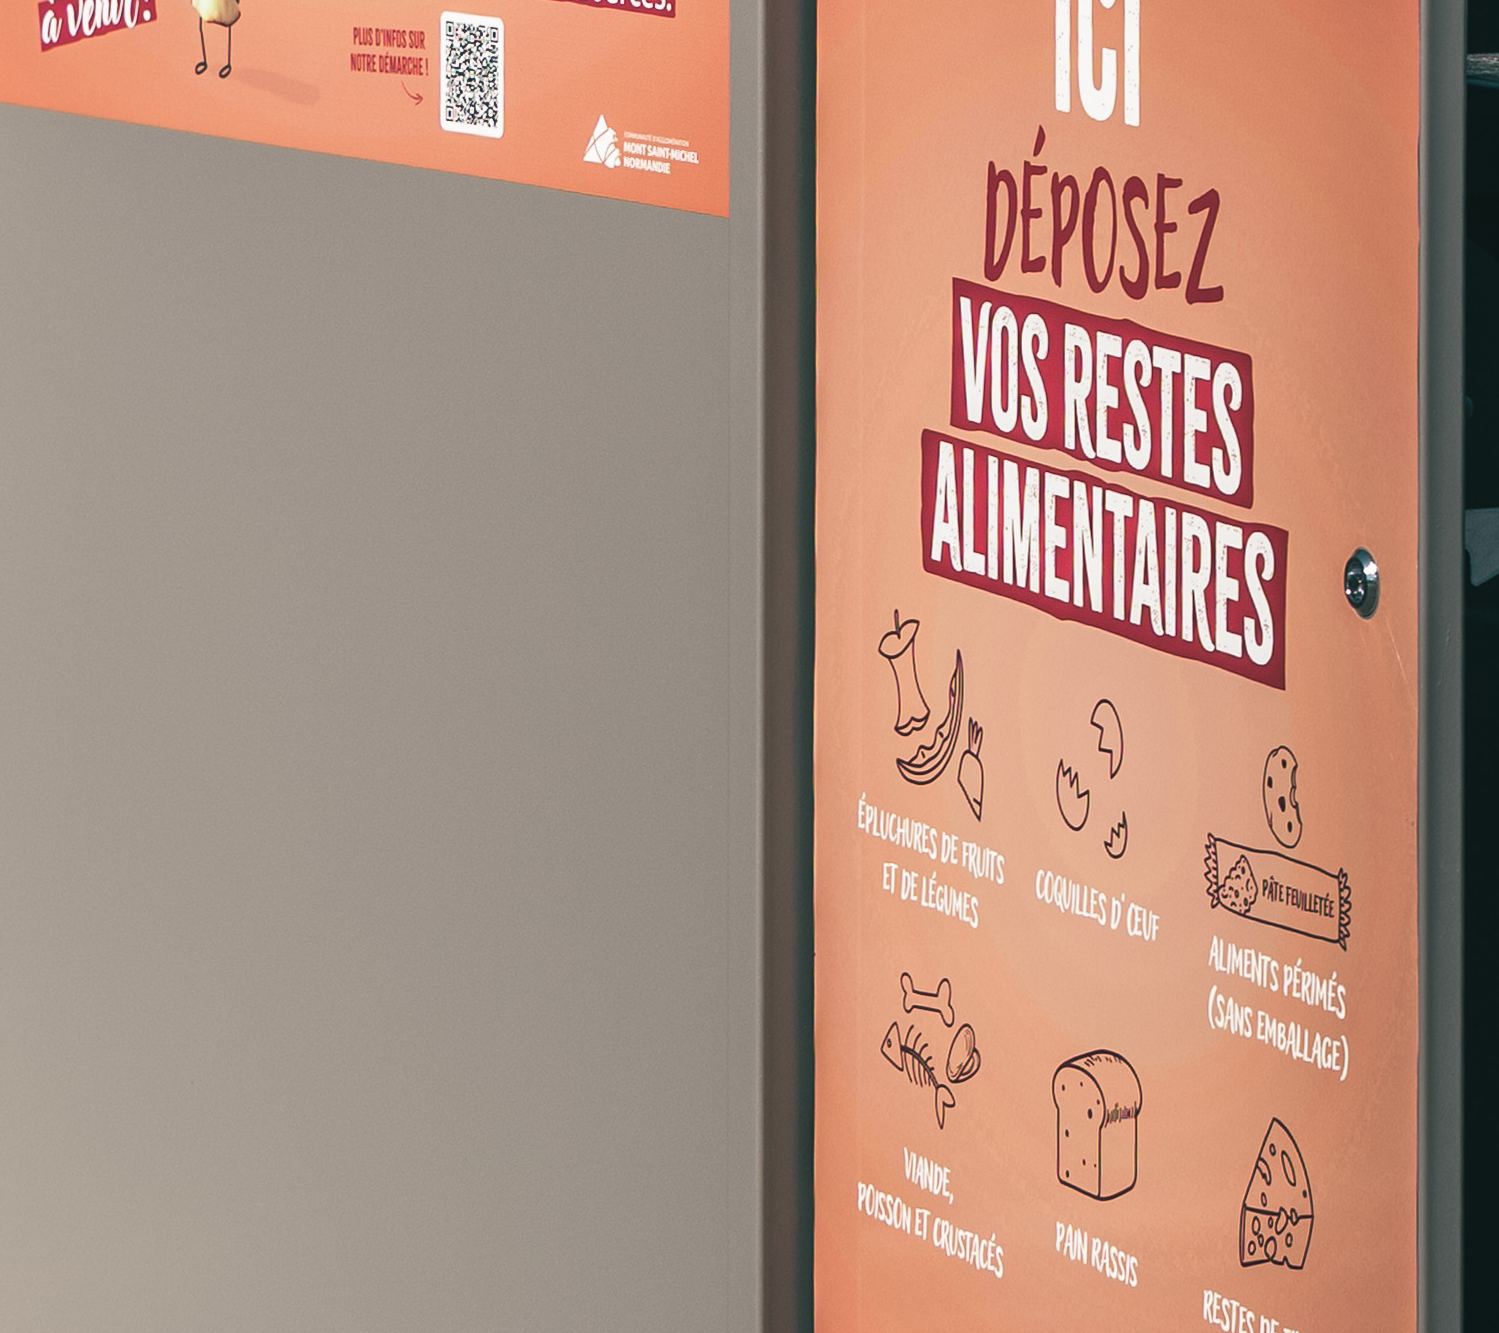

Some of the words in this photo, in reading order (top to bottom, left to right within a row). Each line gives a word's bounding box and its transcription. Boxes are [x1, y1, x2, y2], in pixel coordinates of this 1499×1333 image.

[350, 53, 377, 73] NOTRE
[379, 51, 424, 76] DÉMARCHE
[353, 27, 373, 46] PLUS
[375, 28, 407, 48] D'INFOS
[408, 30, 426, 50] SUR
[623, 141, 647, 155] MONT
[647, 144, 699, 164] SAINT-MICHEL
[623, 156, 671, 175] NORMANDIE
[984, 125, 1225, 305] DÉPOSEZ
[958, 296, 1050, 444] VOS
[1063, 320, 1244, 497] RESTES
[930, 441, 1275, 667] ALIMENTAIRES
[857, 792, 938, 860] ÉPLUCHURES
[941, 831, 959, 865] DE
[962, 841, 1005, 885] FRUITS
[883, 862, 899, 895] ET
[900, 868, 919, 901] DE
[921, 870, 979, 929] LÉGUMES
[1036, 869, 1107, 926] COQUILLES
[1261, 875, 1284, 903] PÂTE
[1286, 885, 1335, 919] FEUILLETÉE
[1208, 935, 1279, 992] ALIMENTS
[1282, 957, 1347, 1020] PÉRIMÉS
[1207, 985, 1253, 1039] (SANS
[1257, 1010, 1349, 1082] EMBALLAGE)
[903, 1146, 954, 1205] VIANDE,
[857, 1181, 912, 1234] POISSON
[914, 1207, 931, 1241] ET
[933, 1217, 1004, 1279] CRUSTACÉS
[1055, 1220, 1088, 1265] PAIN
[1091, 1237, 1139, 1288] RASSIS
